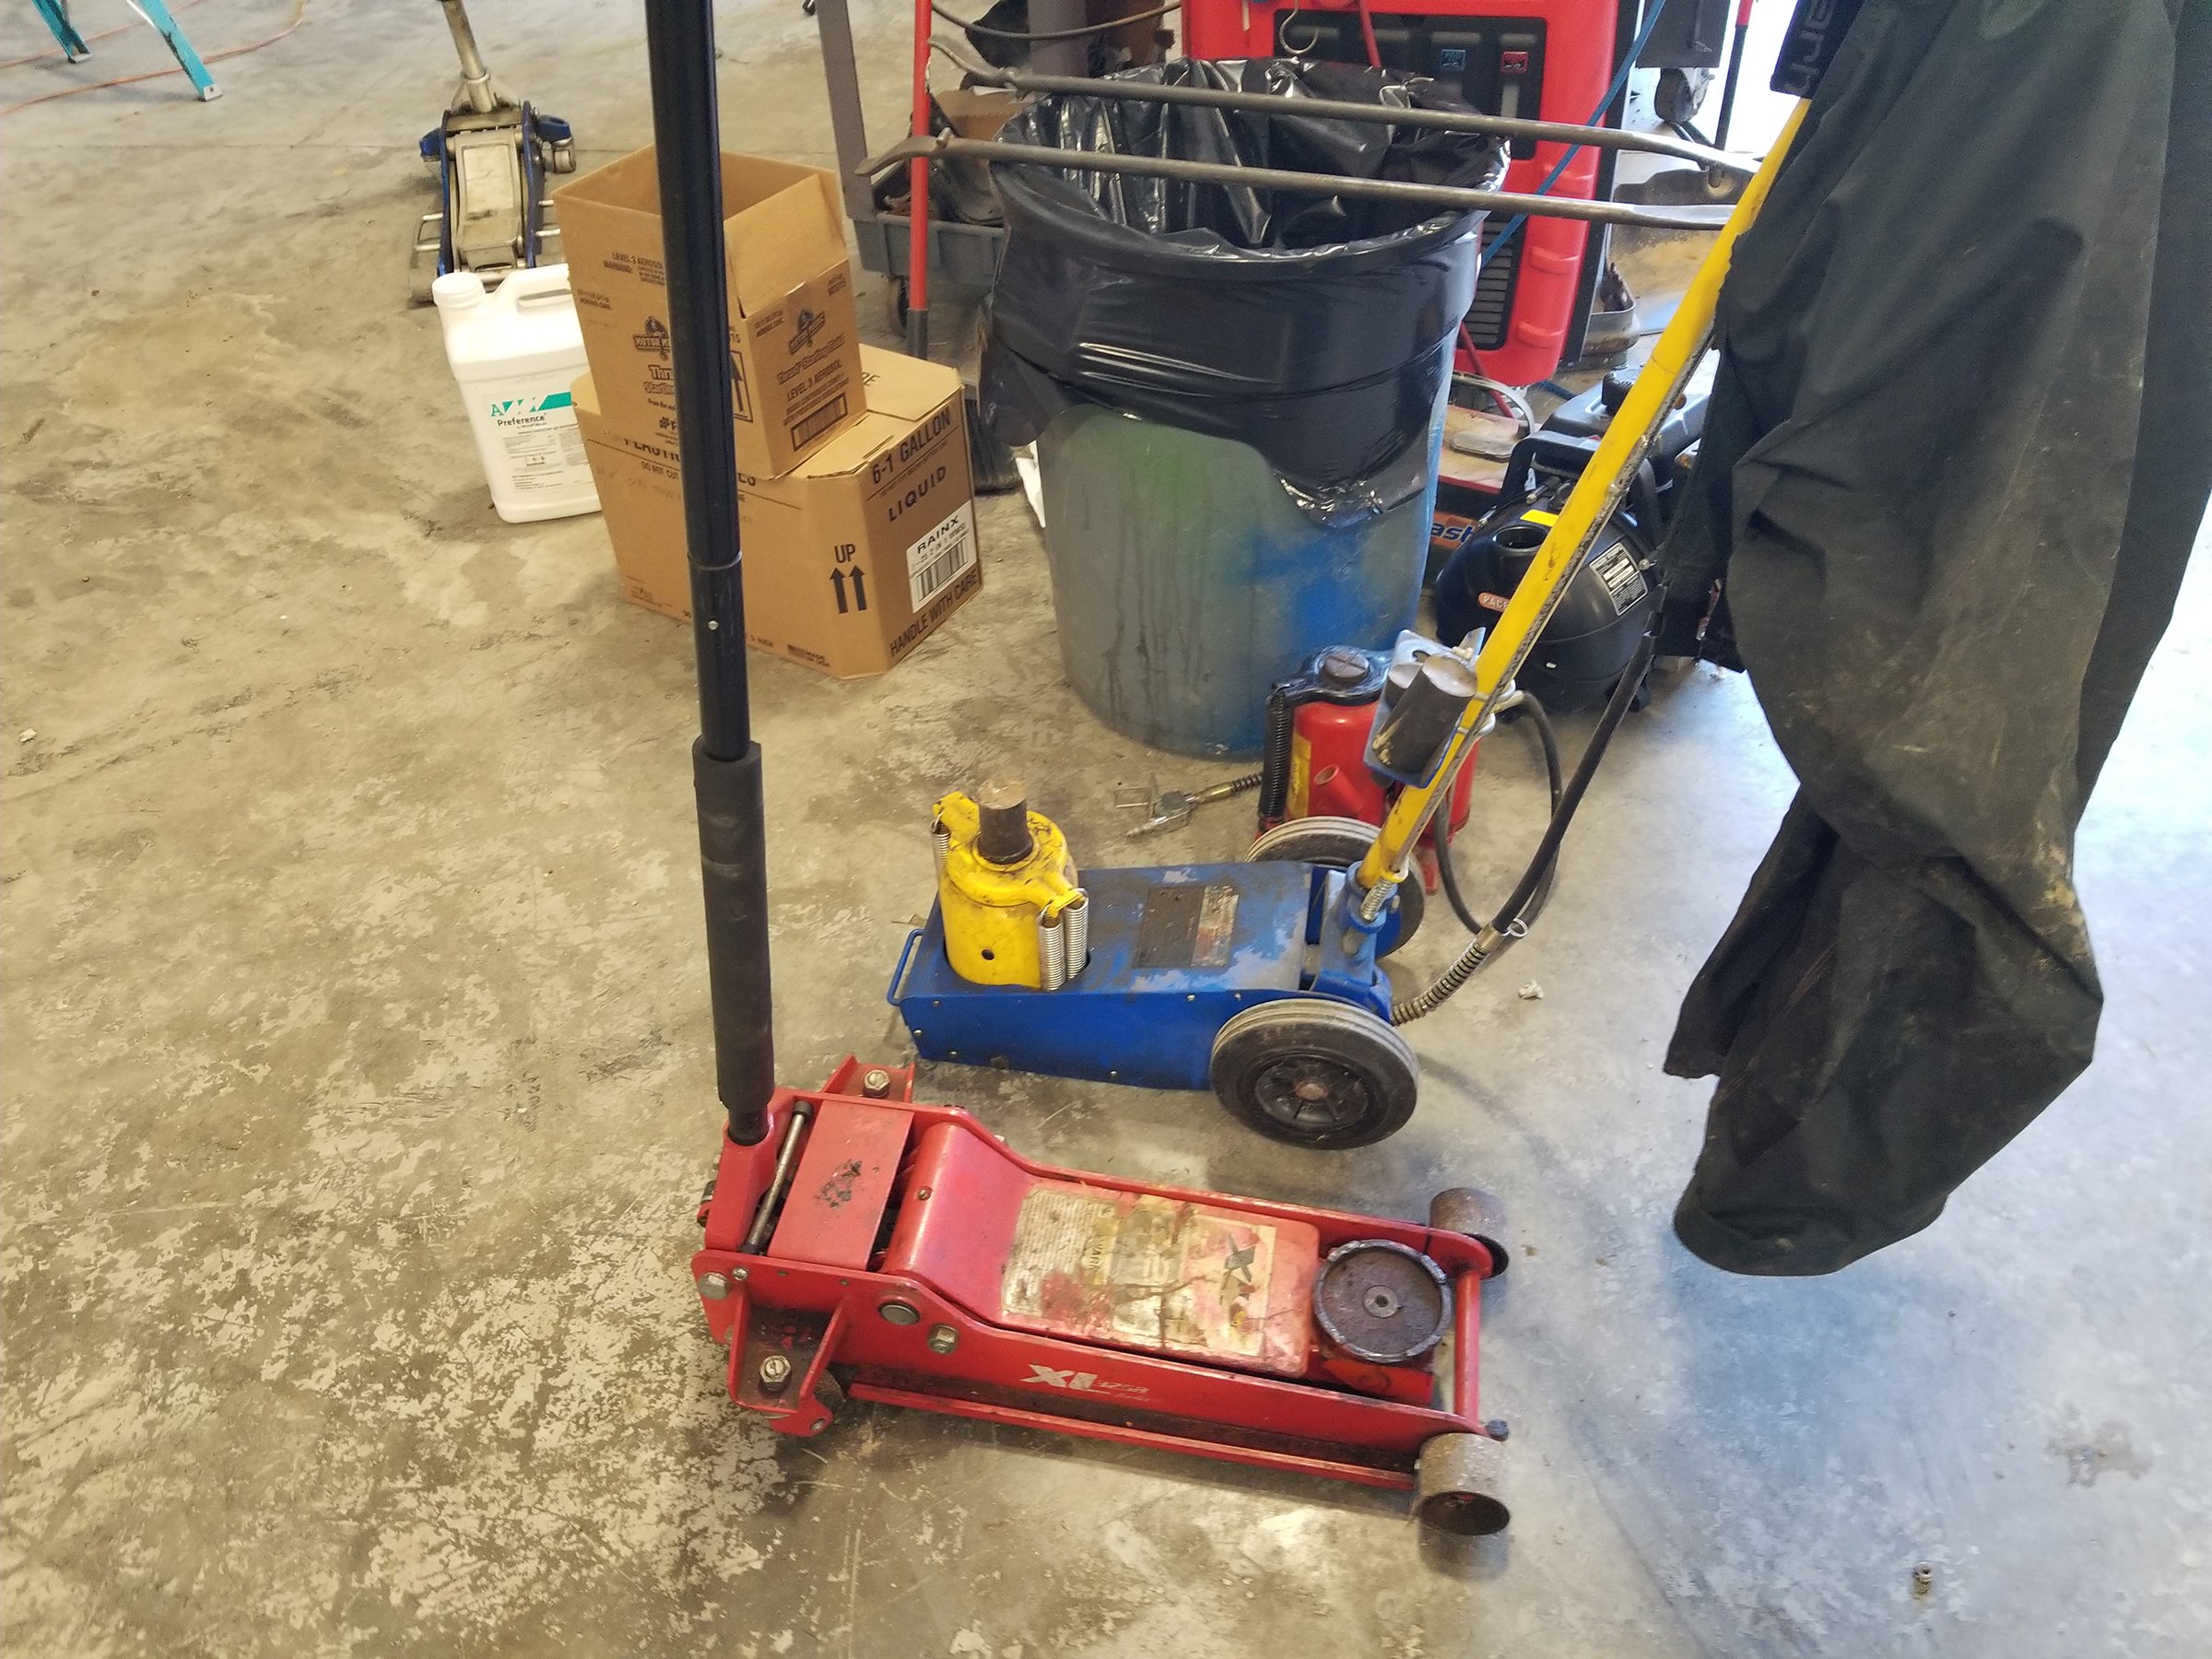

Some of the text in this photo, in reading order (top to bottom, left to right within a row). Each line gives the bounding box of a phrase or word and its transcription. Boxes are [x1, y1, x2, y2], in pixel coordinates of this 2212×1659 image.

[497, 415, 546, 426] Preference
[871, 453, 894, 484] 6-1
[900, 406, 951, 463] GALLON
[888, 465, 947, 522] LIQUID
[834, 543, 856, 564] UP
[917, 514, 959, 554] RAINX
[890, 568, 978, 657] HANDLE WITH CARE
[1020, 1364, 1110, 1394] XL
